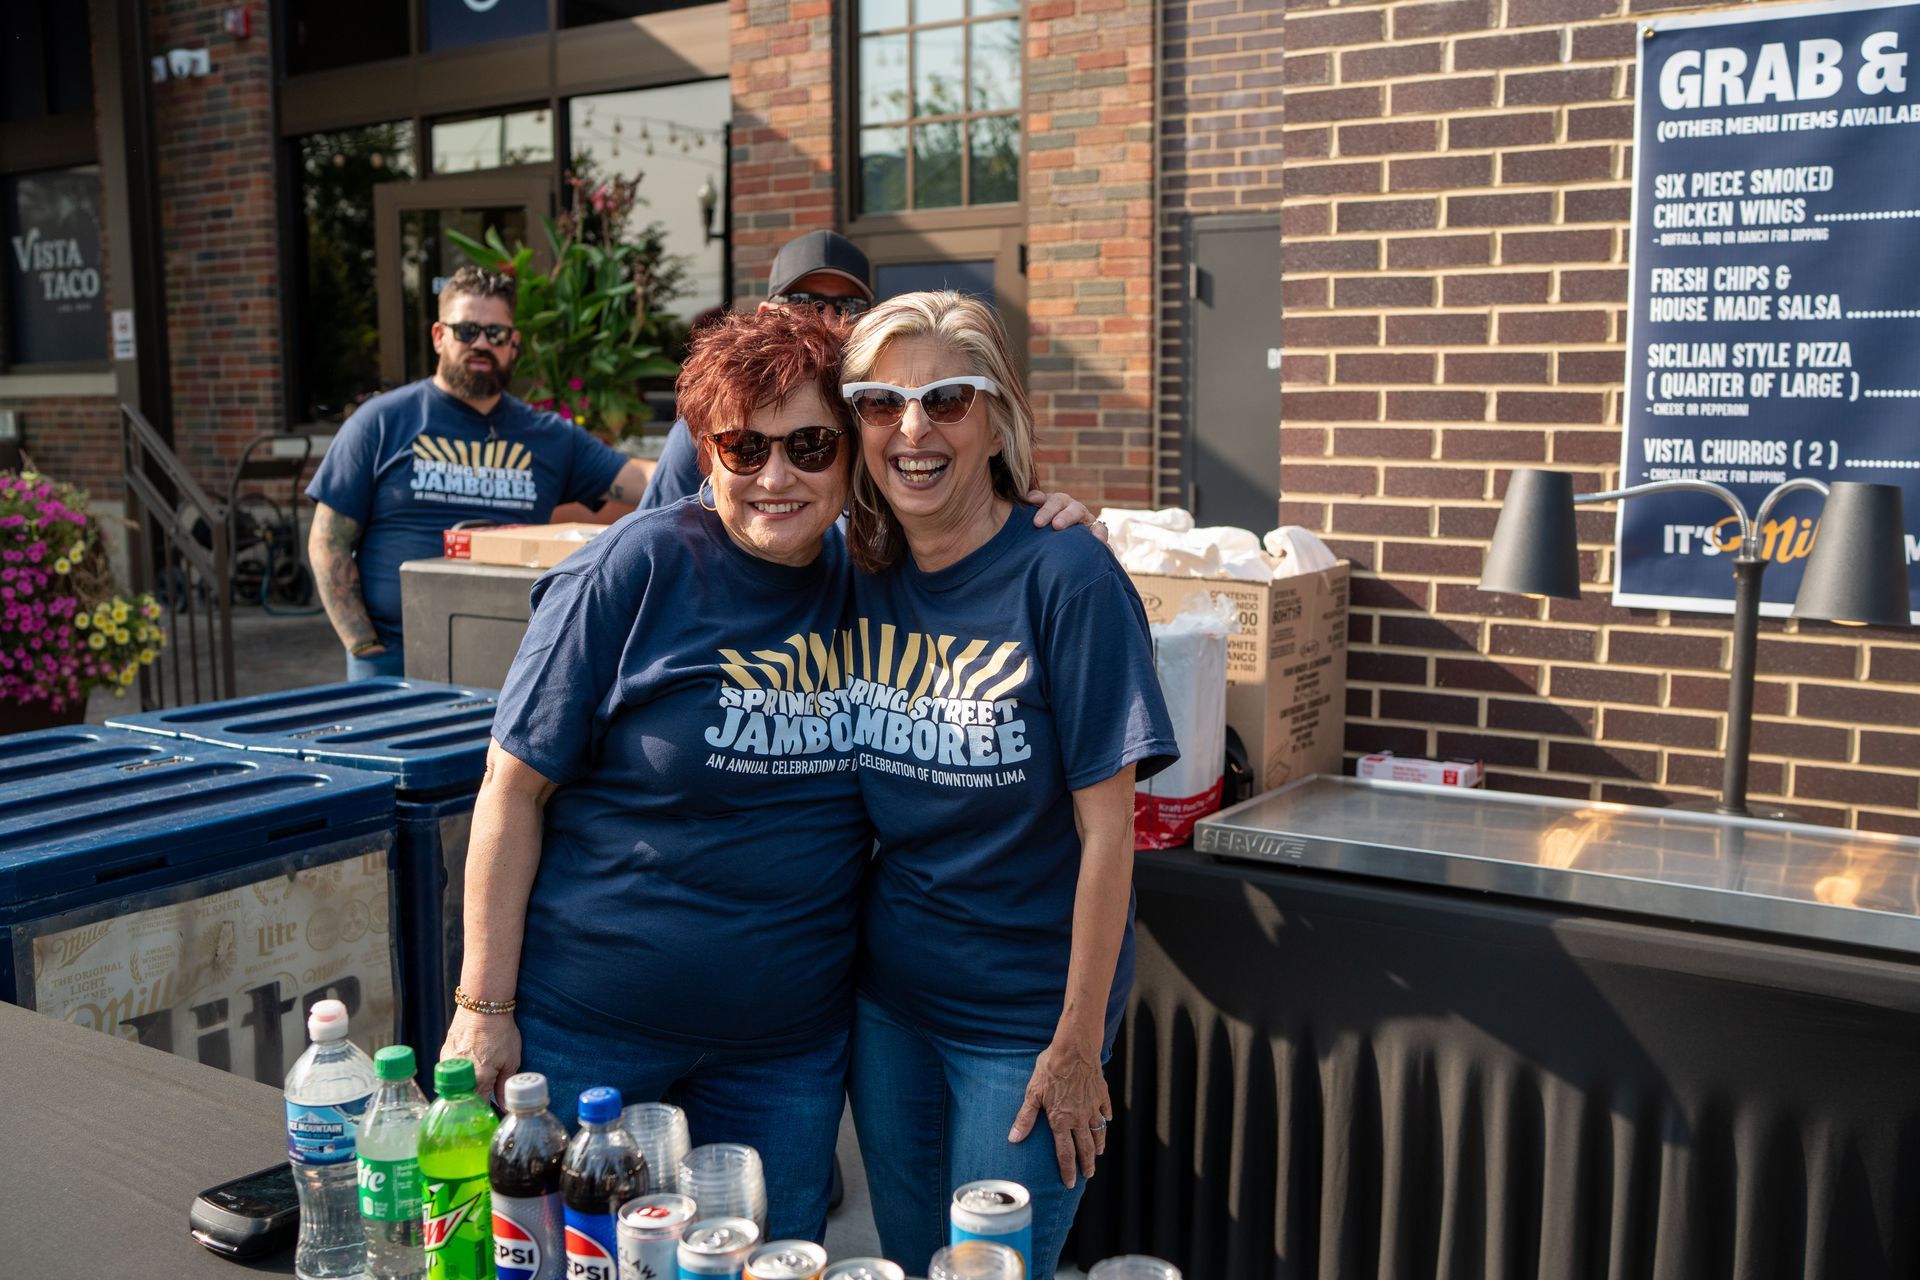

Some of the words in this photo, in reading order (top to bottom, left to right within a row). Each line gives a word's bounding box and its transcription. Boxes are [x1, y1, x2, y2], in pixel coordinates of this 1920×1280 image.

[1659, 38, 1843, 111] GRAB
[1857, 31, 1908, 96] &
[1657, 119, 1723, 143] (OTHER
[1728, 114, 1778, 135] MENU
[1781, 110, 1838, 132] ITEMS
[1654, 173, 1686, 200] SIX
[1691, 170, 1745, 197] PIECE
[1750, 165, 1834, 195] SMOKED
[1653, 201, 1733, 229] CHICKEN
[1740, 198, 1806, 224] WINGS
[12, 227, 83, 273] VISTA
[40, 267, 101, 300] TACO
[1651, 266, 1708, 293] FRESH
[1713, 265, 1769, 292] CHIPS
[1775, 264, 1792, 291] &
[1650, 296, 1708, 322] HOUSE
[1713, 295, 1772, 322] MADE
[1777, 294, 1842, 321] SALSA
[1647, 342, 1726, 369] SICILIAN
[1732, 342, 1791, 368] STYLE
[1796, 341, 1852, 368] PIZZA
[1660, 372, 1744, 399] QUARTER
[1750, 372, 1776, 398] OF
[1780, 372, 1844, 398] LARGE
[413, 458, 474, 478] SPRING
[1643, 438, 1695, 464] VISTA
[1701, 439, 1787, 465] CHURROS
[1809, 441, 1823, 467] 2
[410, 470, 538, 501] JAMBOREE
[719, 687, 815, 718] SPRING
[910, 695, 1018, 726] STREET
[706, 752, 726, 770] AN
[726, 756, 769, 775] ANNUAL
[771, 758, 836, 775] CELEBRATION
[837, 758, 850, 772] OF
[859, 752, 916, 779] CELEBRATION
[917, 766, 930, 782] OF
[931, 770, 993, 789] DOWNTOWN
[996, 768, 1027, 787] LIMA
[256, 920, 298, 958] Lite
[51, 975, 74, 988] THE
[74, 961, 124, 983] ORIGINAL
[70, 976, 107, 996] LIGHT
